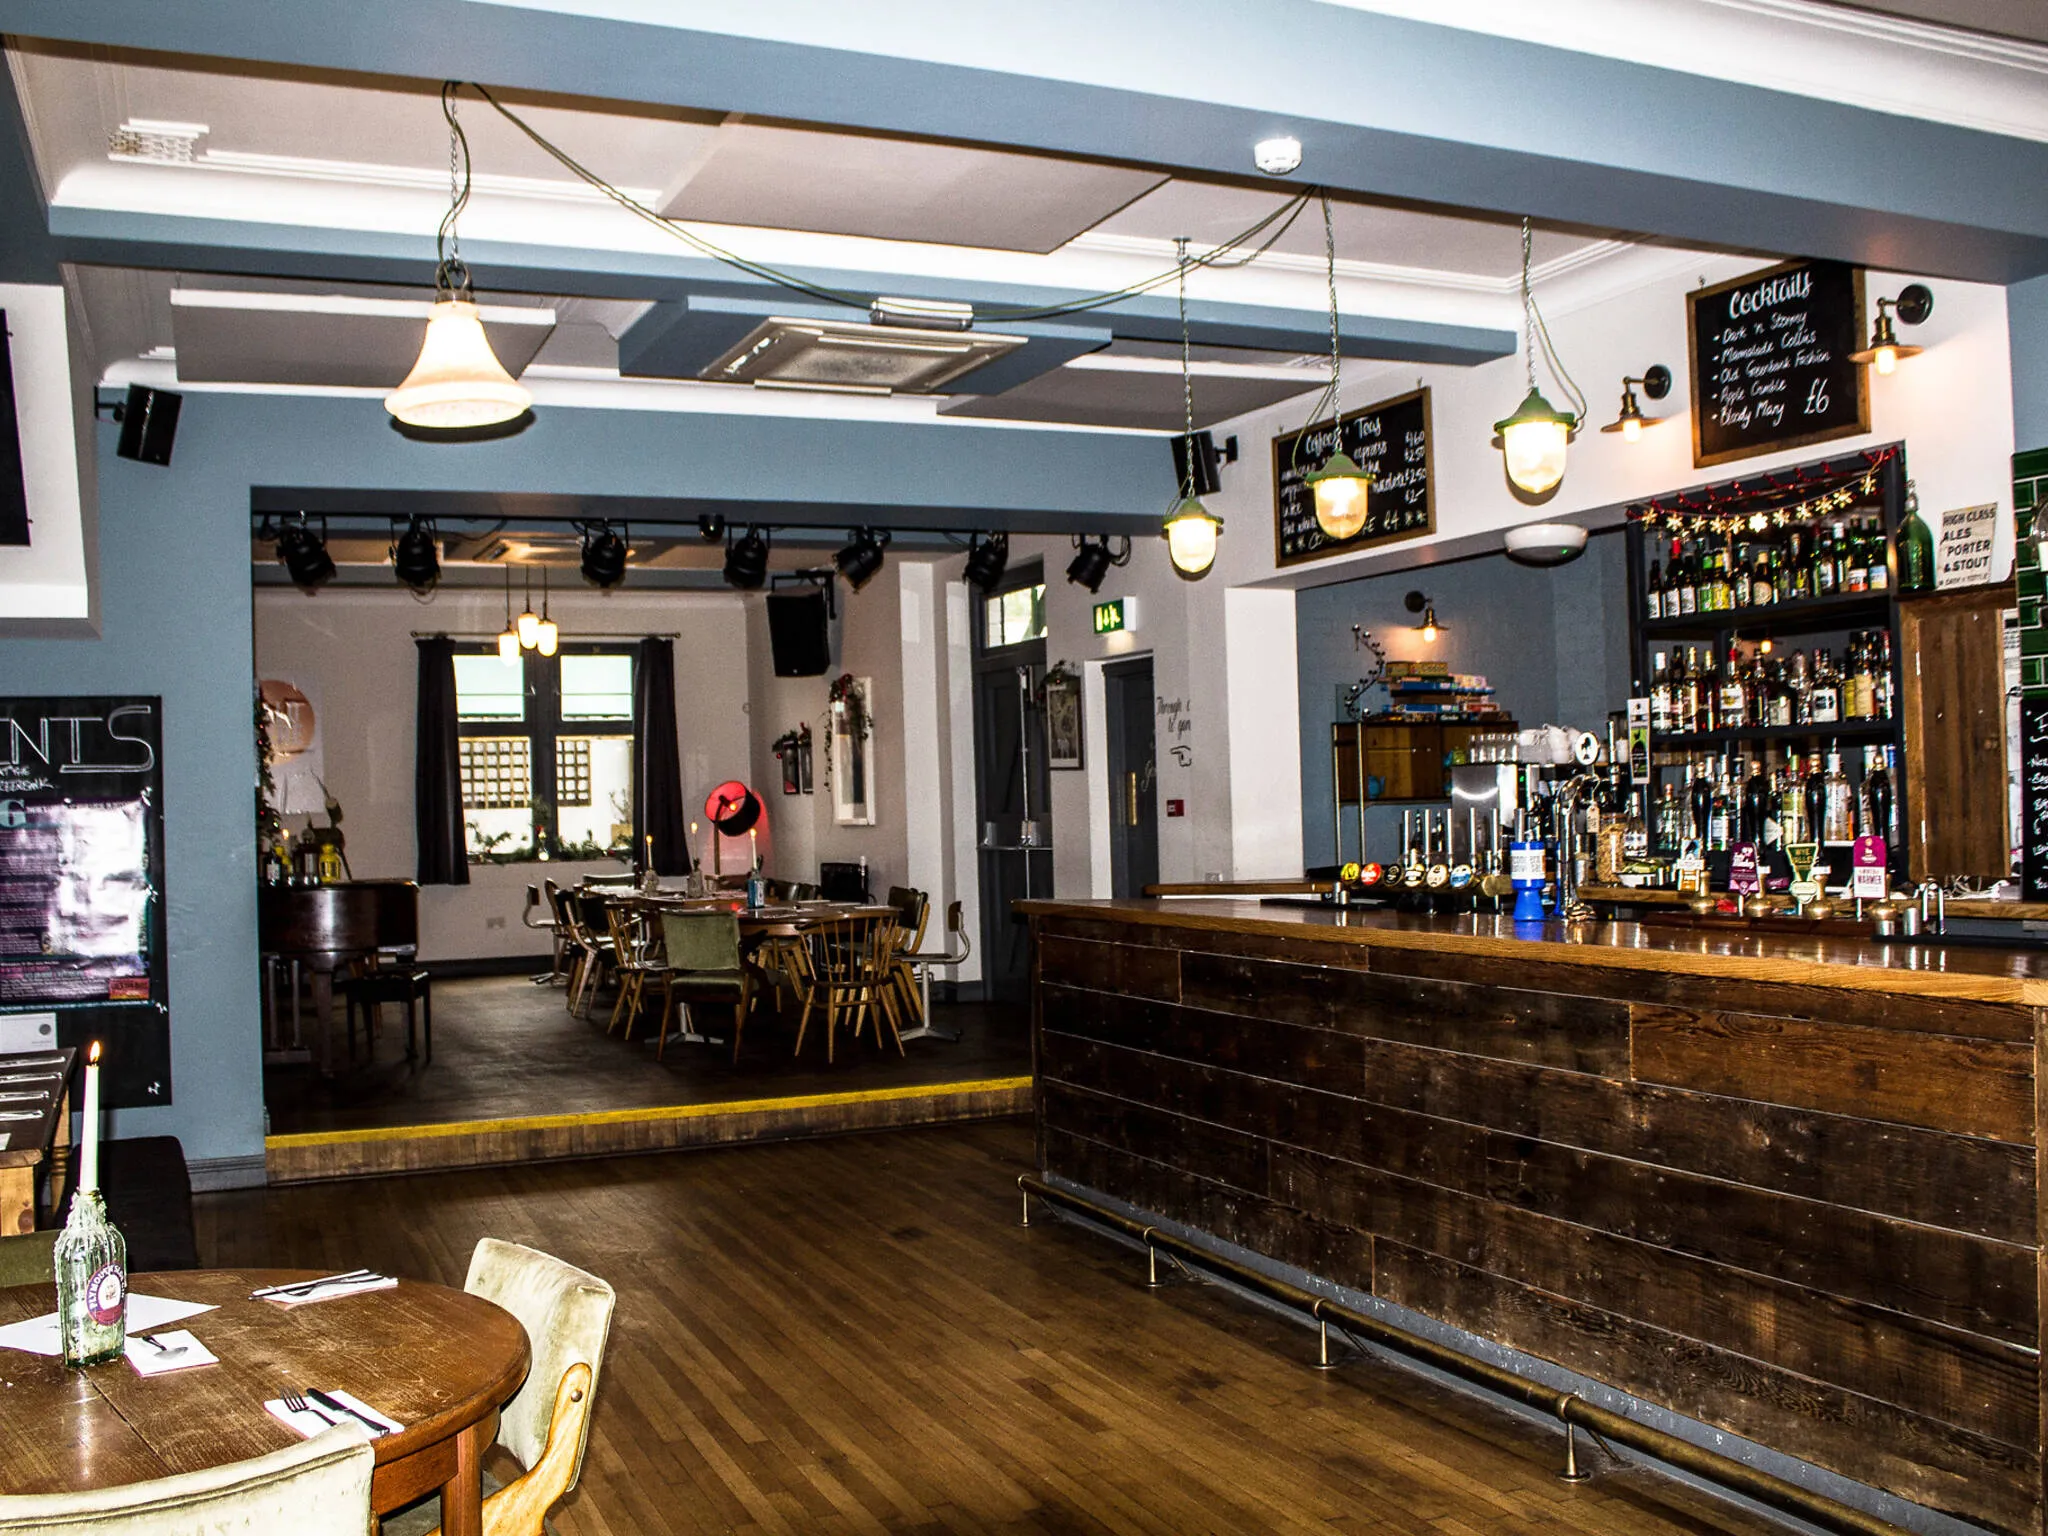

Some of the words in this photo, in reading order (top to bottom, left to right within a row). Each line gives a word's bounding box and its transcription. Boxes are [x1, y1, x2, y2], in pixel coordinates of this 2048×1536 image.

[1804, 378, 1830, 414] £6
[1755, 400, 1785, 427] Mary
[1940, 527, 1972, 546] ALES
[1946, 539, 1992, 556] PORTER
[1952, 556, 1990, 572] STOUT
